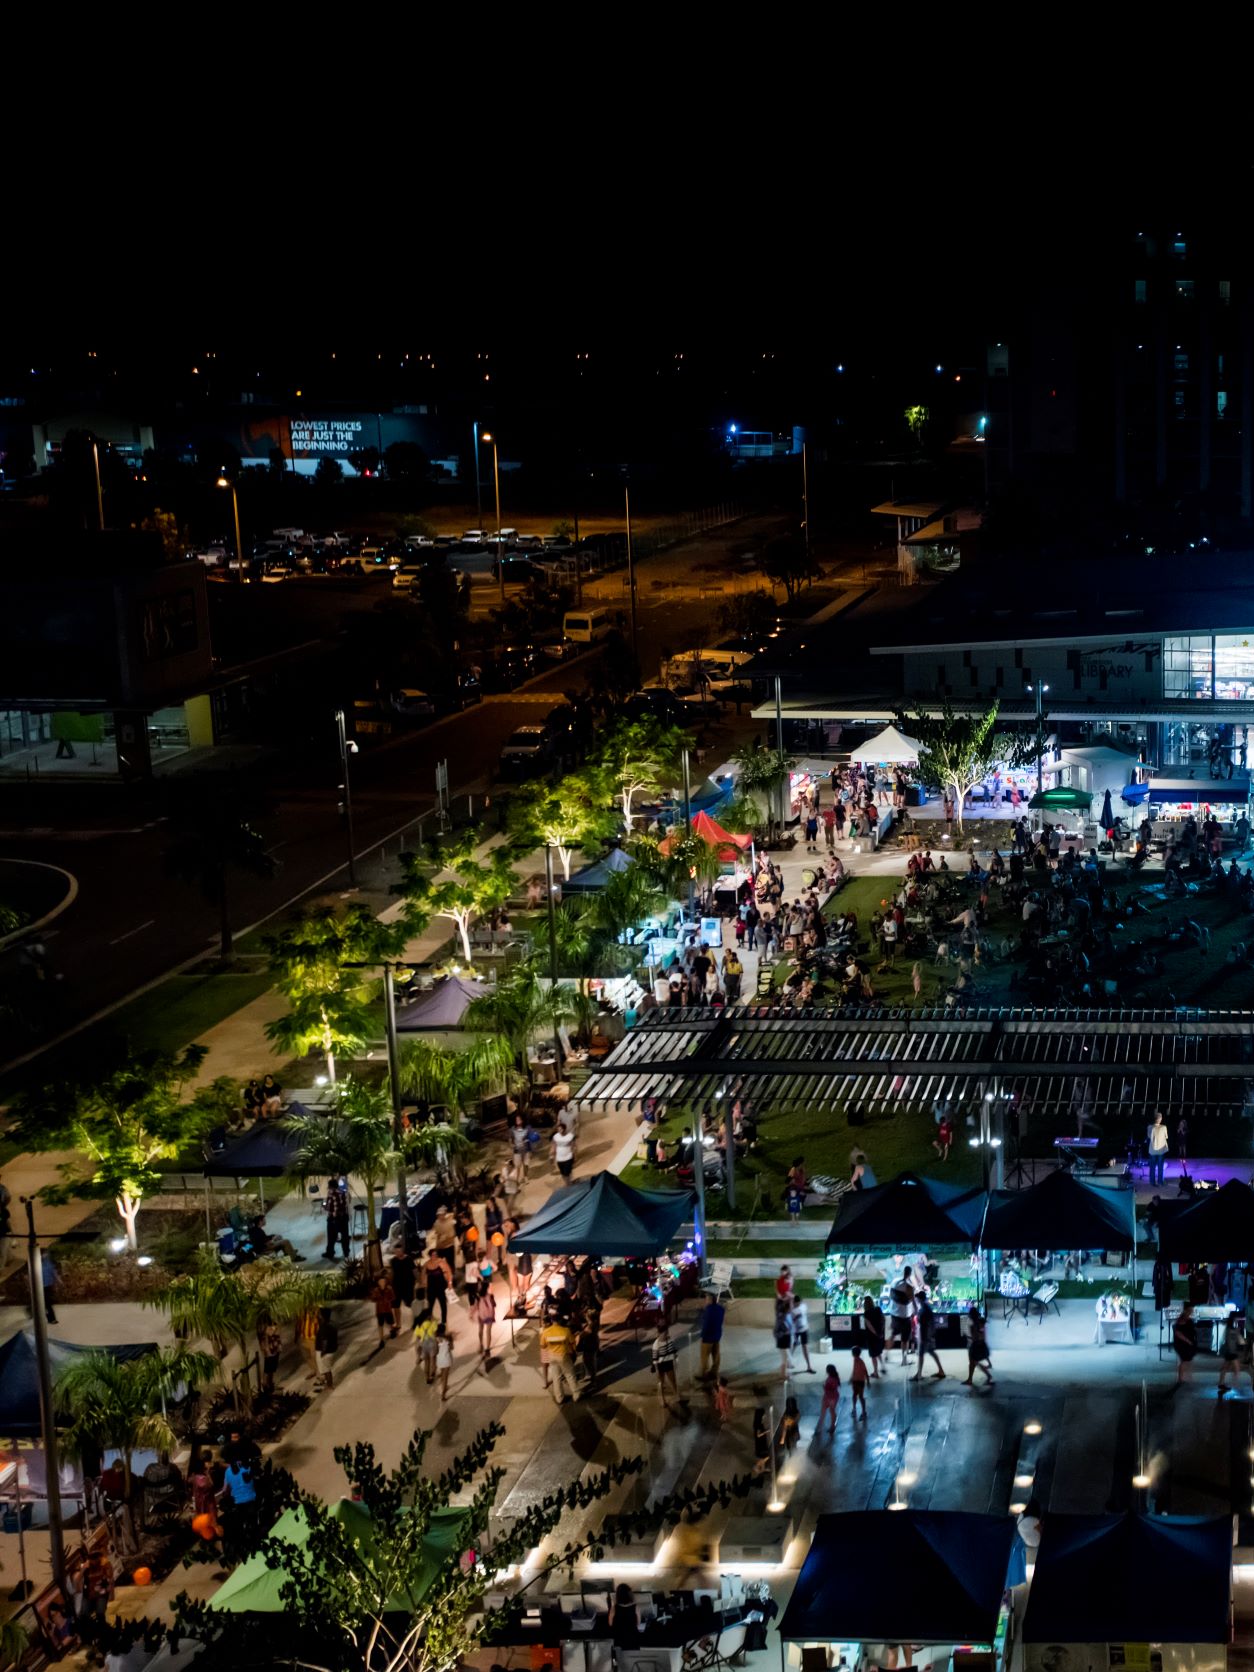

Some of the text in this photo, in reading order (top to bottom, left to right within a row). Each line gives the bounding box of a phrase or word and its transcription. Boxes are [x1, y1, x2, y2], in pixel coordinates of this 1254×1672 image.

[290, 421, 362, 431] LOWEST PRICES
[291, 431, 353, 441] ARE JUST THE
[292, 441, 348, 451] BEGINNING
[1081, 664, 1133, 679] LIBRARY
